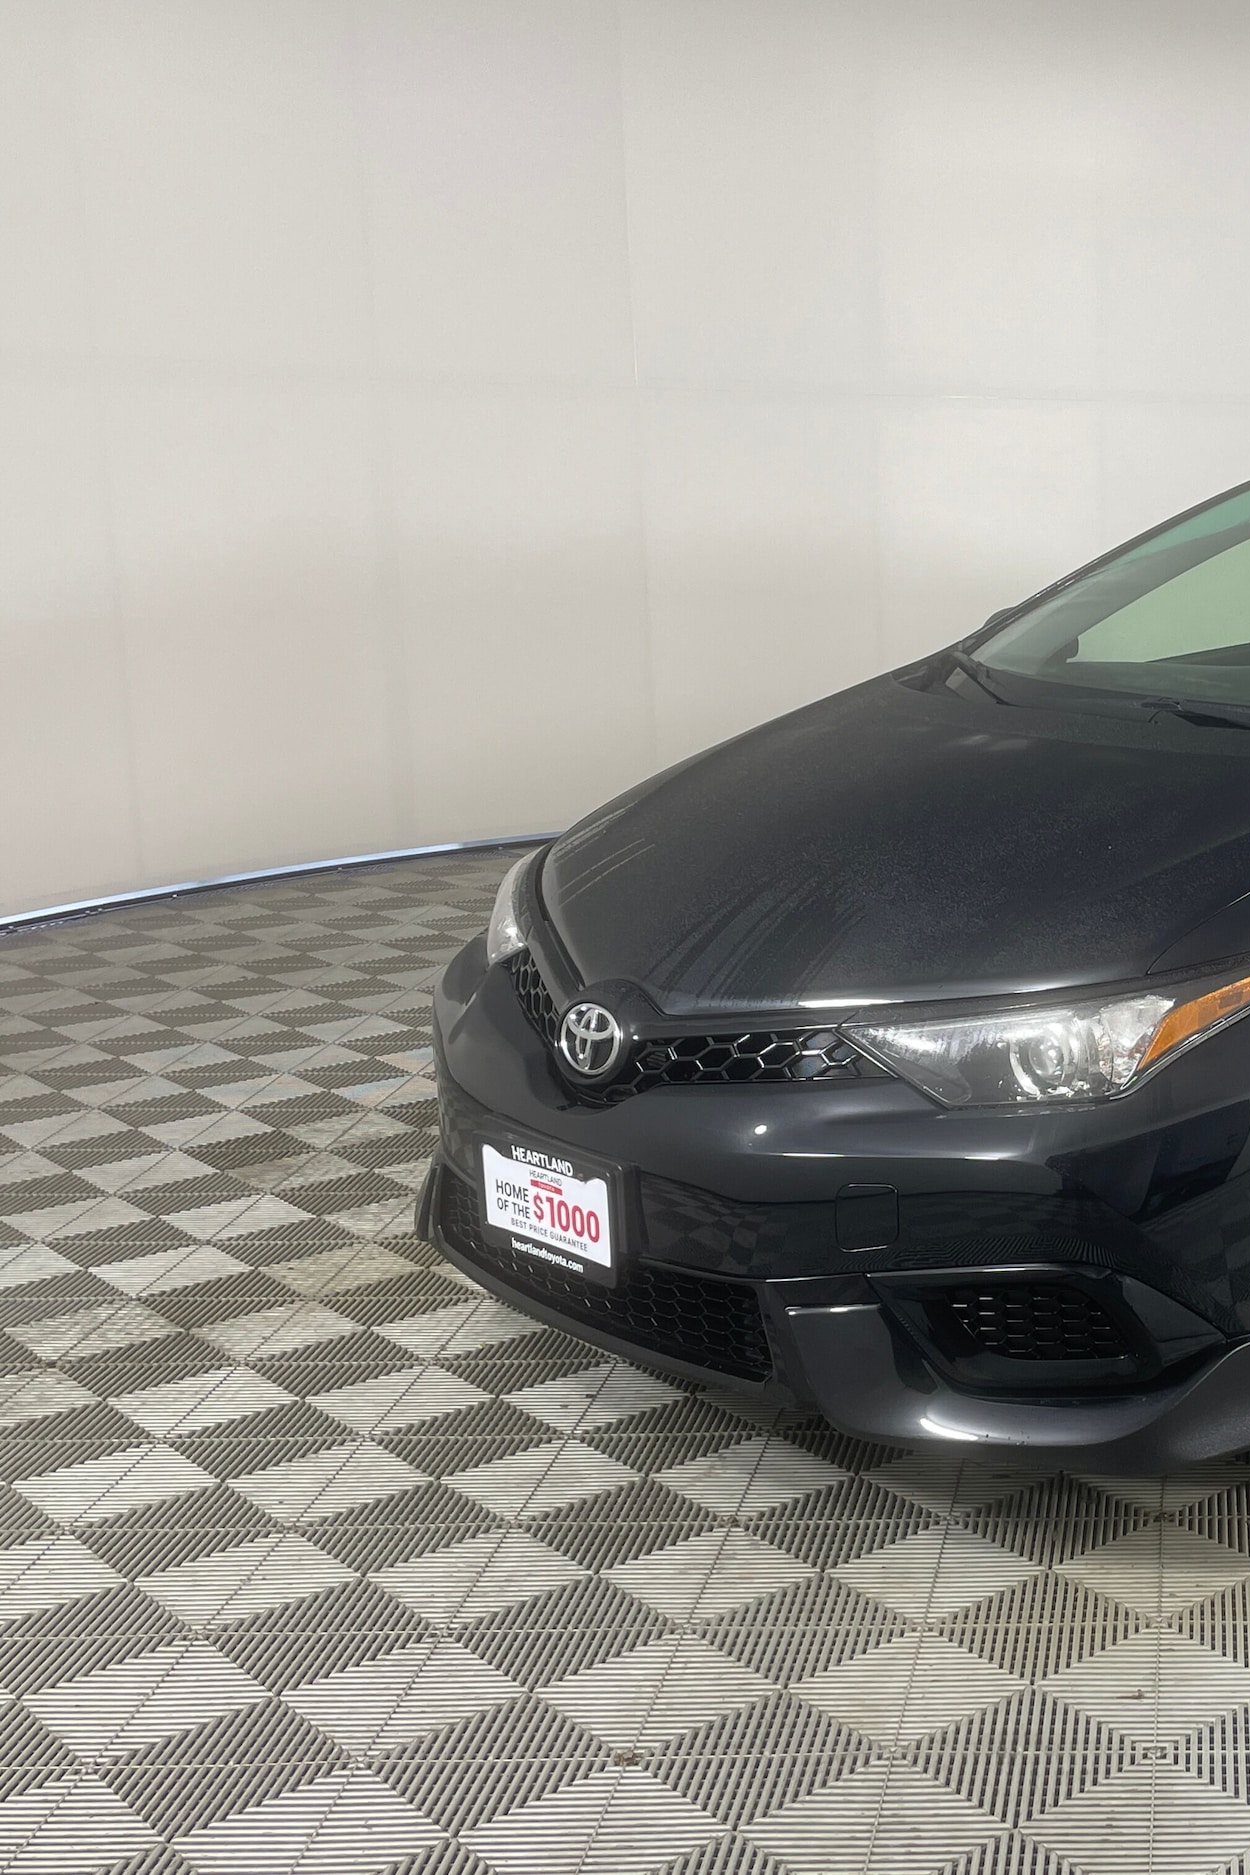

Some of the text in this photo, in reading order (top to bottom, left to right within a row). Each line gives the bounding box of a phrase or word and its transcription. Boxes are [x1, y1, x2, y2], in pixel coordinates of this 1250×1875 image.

[511, 1145, 573, 1176] HEARTLAND
[496, 1179, 529, 1203] HOME
[529, 1169, 563, 1187] HEARTLAND
[497, 1198, 531, 1220] OF THE
[533, 1192, 600, 1243] $1000
[511, 1217, 588, 1252] BEST PRICE GUARANTEE
[511, 1238, 584, 1273] heartlandtoyota.com
